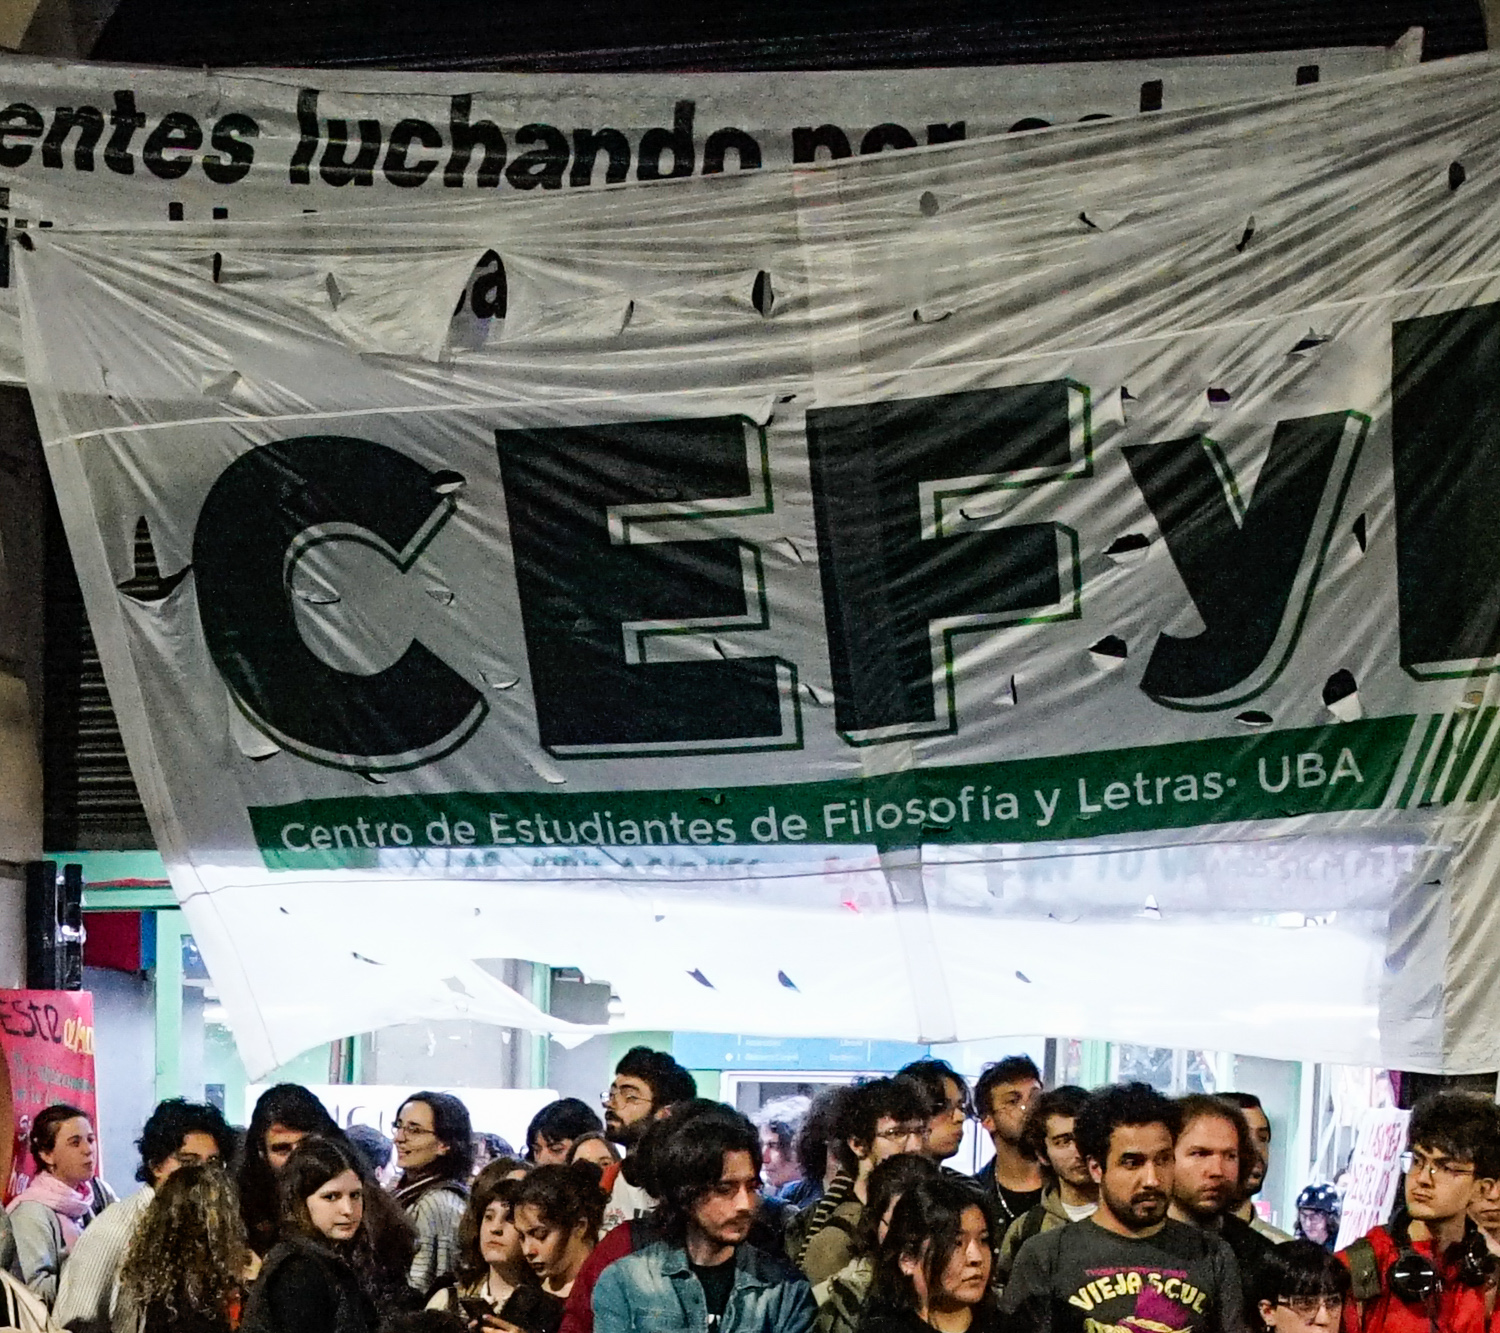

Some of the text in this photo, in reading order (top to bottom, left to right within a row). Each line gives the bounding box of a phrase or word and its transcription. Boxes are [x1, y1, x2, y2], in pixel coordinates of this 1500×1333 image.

[290, 89, 763, 190] luchando
[281, 814, 413, 852] Centro
[426, 811, 477, 847] de
[492, 806, 737, 848] Estudiantes
[750, 806, 808, 842] de
[822, 785, 1020, 839] Filosofía
[1035, 786, 1060, 827] y
[1258, 747, 1364, 794] UBA
[1068, 1271, 1143, 1311] VIEJA
